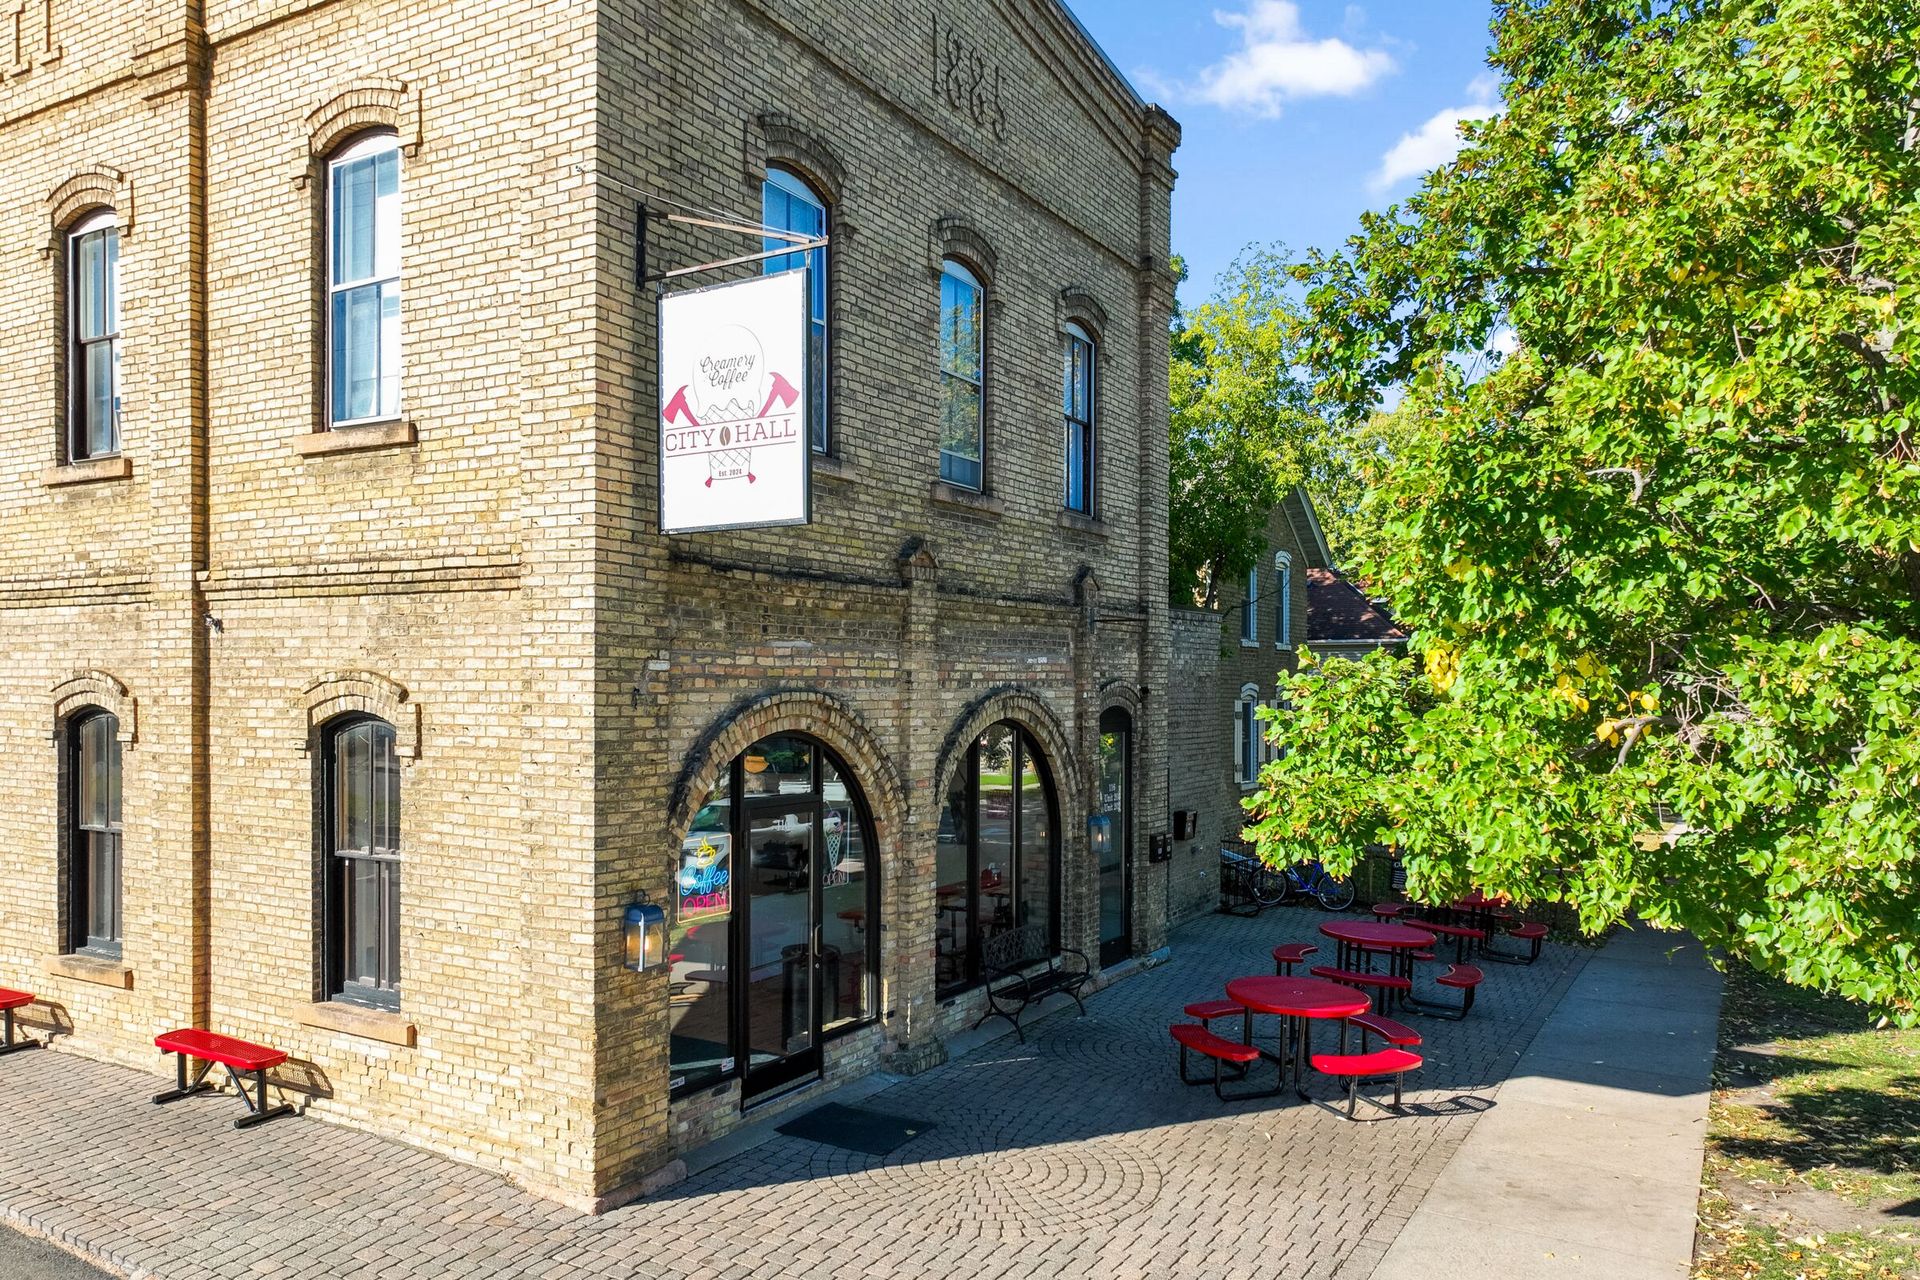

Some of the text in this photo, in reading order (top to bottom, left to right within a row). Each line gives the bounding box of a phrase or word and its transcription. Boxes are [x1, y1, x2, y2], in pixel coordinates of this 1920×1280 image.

[932, 13, 1007, 142] 1885
[700, 354, 756, 374] Creamery
[708, 368, 749, 390] Coffee
[665, 419, 796, 452] CITY HALL
[680, 865, 729, 896] Coffee
[822, 871, 845, 886] OPEN
[682, 892, 728, 917] OPEN
